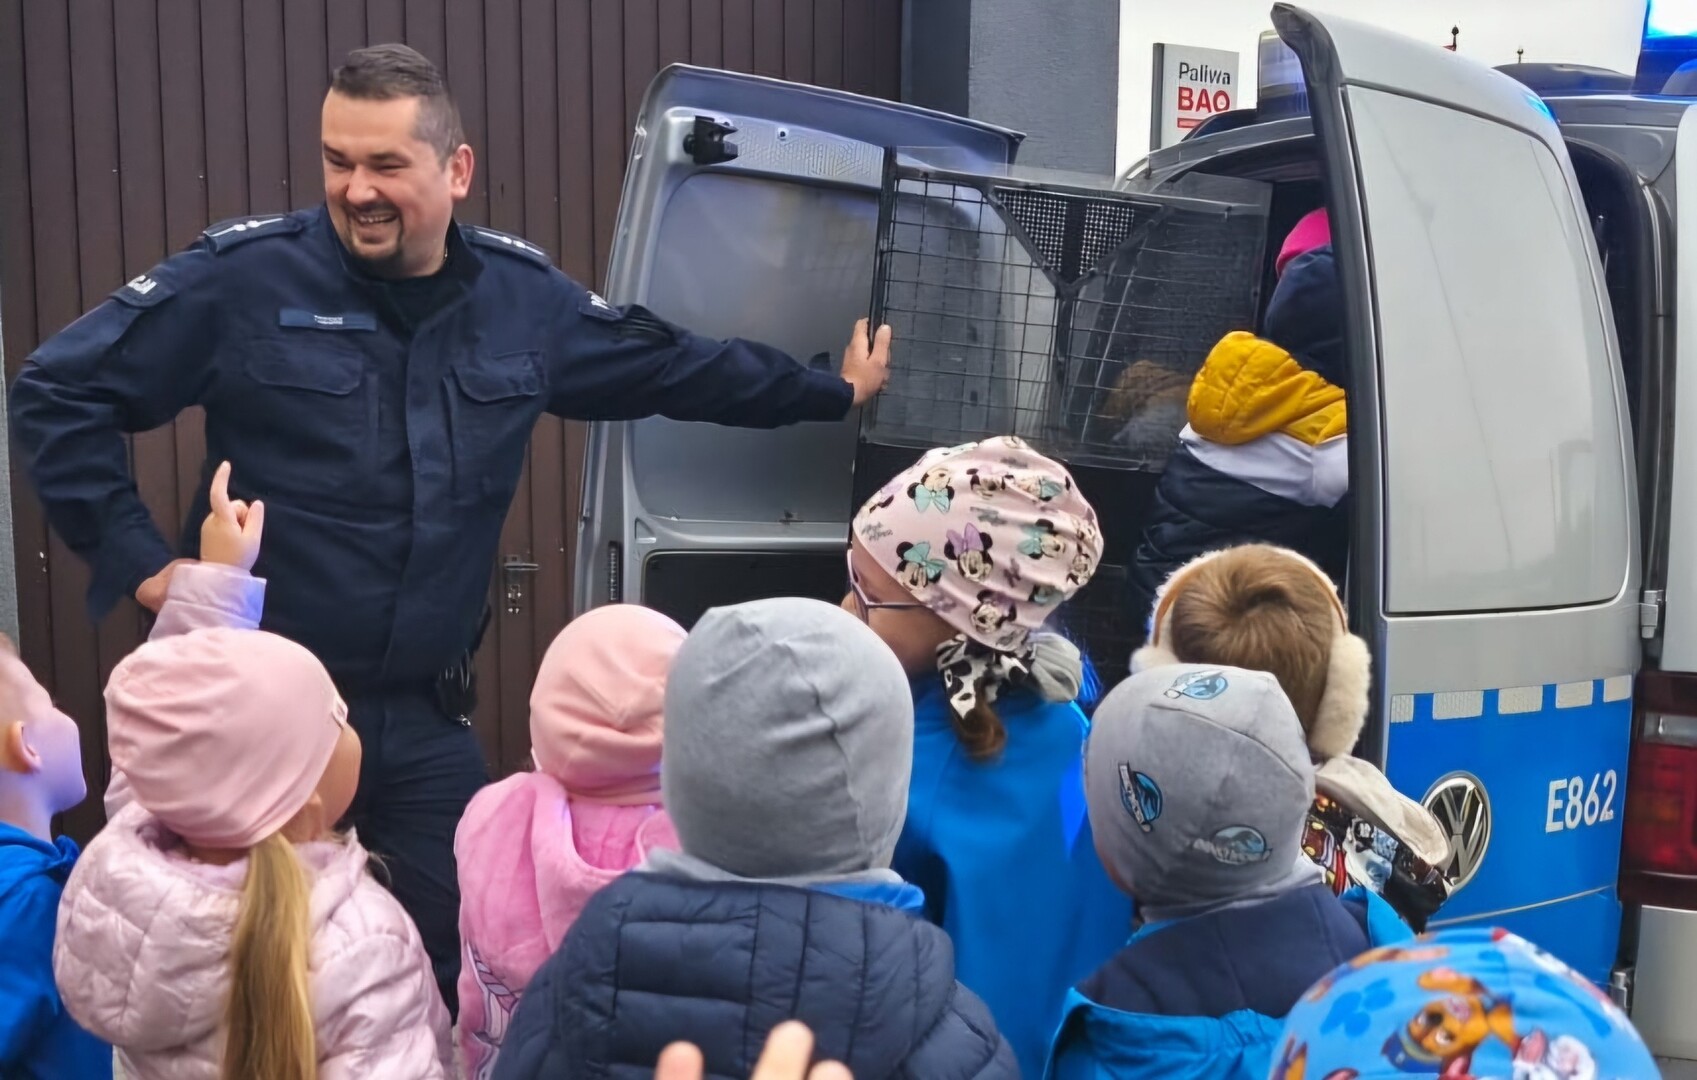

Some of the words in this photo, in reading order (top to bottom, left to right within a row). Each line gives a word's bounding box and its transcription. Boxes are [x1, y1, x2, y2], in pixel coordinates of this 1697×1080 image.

[1179, 62, 1231, 85] Paliwa
[1177, 86, 1231, 113] BAO
[1545, 769, 1617, 833] E862
